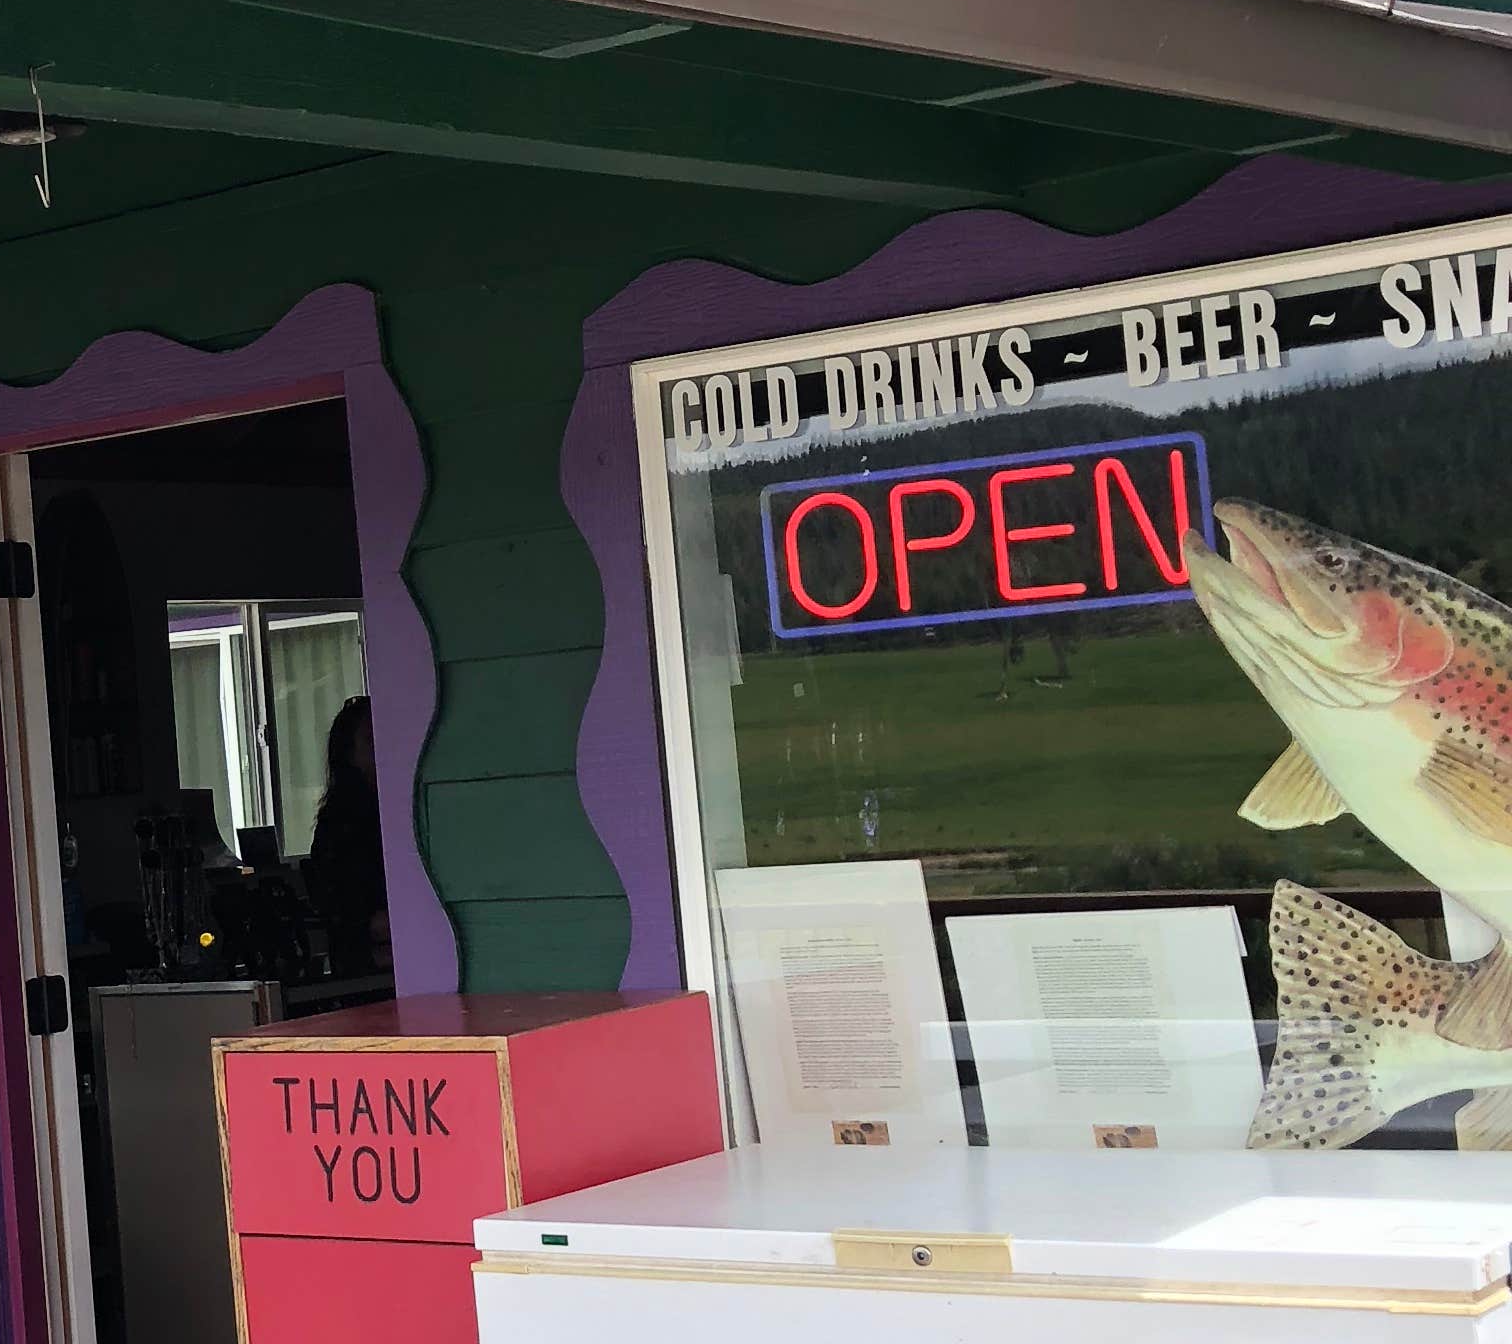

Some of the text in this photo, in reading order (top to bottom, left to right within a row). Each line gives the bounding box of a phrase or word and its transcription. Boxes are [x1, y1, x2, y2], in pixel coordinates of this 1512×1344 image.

[671, 366, 800, 453] COLD
[824, 327, 1035, 431] DRINKS
[1121, 289, 1281, 388] BEER
[785, 449, 1191, 620] OPEN
[272, 1077, 451, 1136] THANK
[314, 1144, 422, 1204] YOU
